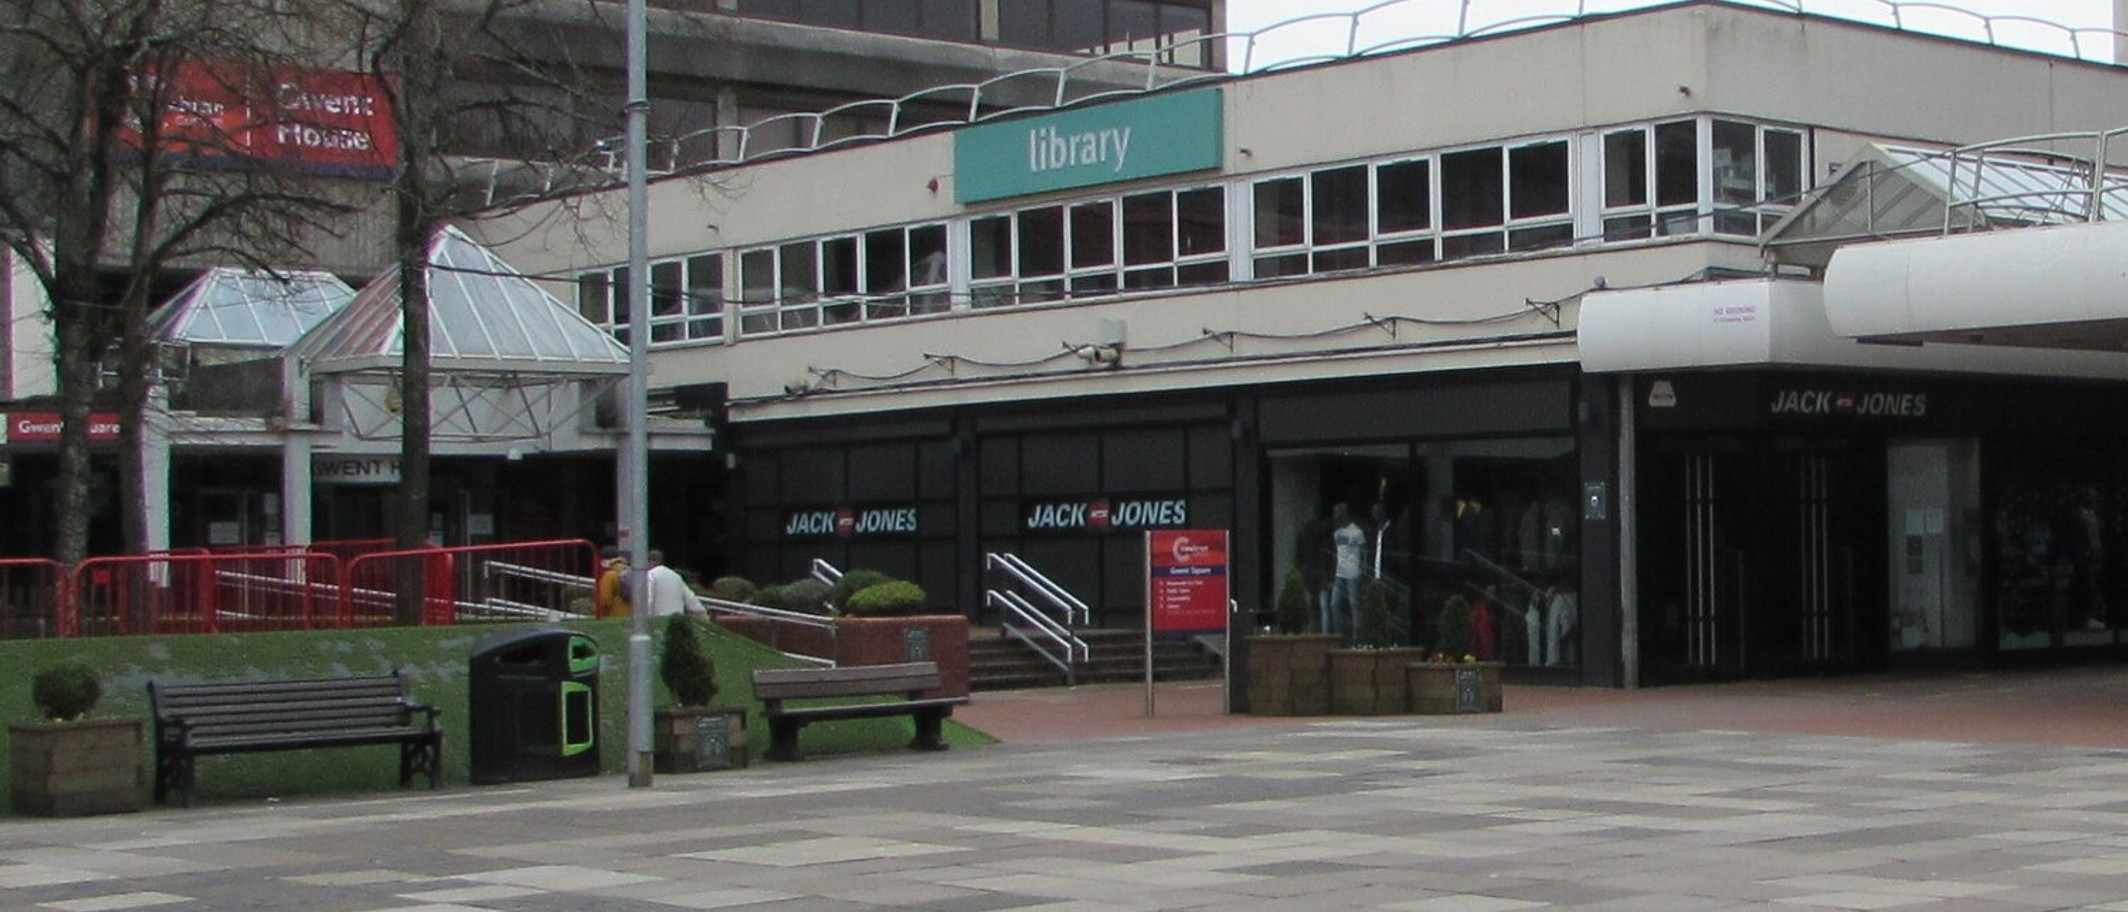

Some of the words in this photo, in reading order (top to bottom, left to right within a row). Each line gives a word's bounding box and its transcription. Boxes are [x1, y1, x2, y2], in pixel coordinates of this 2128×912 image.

[277, 83, 375, 117] Gwent
[277, 121, 371, 150] House
[1030, 126, 1131, 172] library
[1770, 390, 1832, 414] JACK
[1856, 392, 1928, 416] JONES
[786, 511, 836, 535] JACK
[855, 508, 918, 532] JONES
[1027, 503, 1088, 528] JACK
[1111, 499, 1187, 526] JONES
